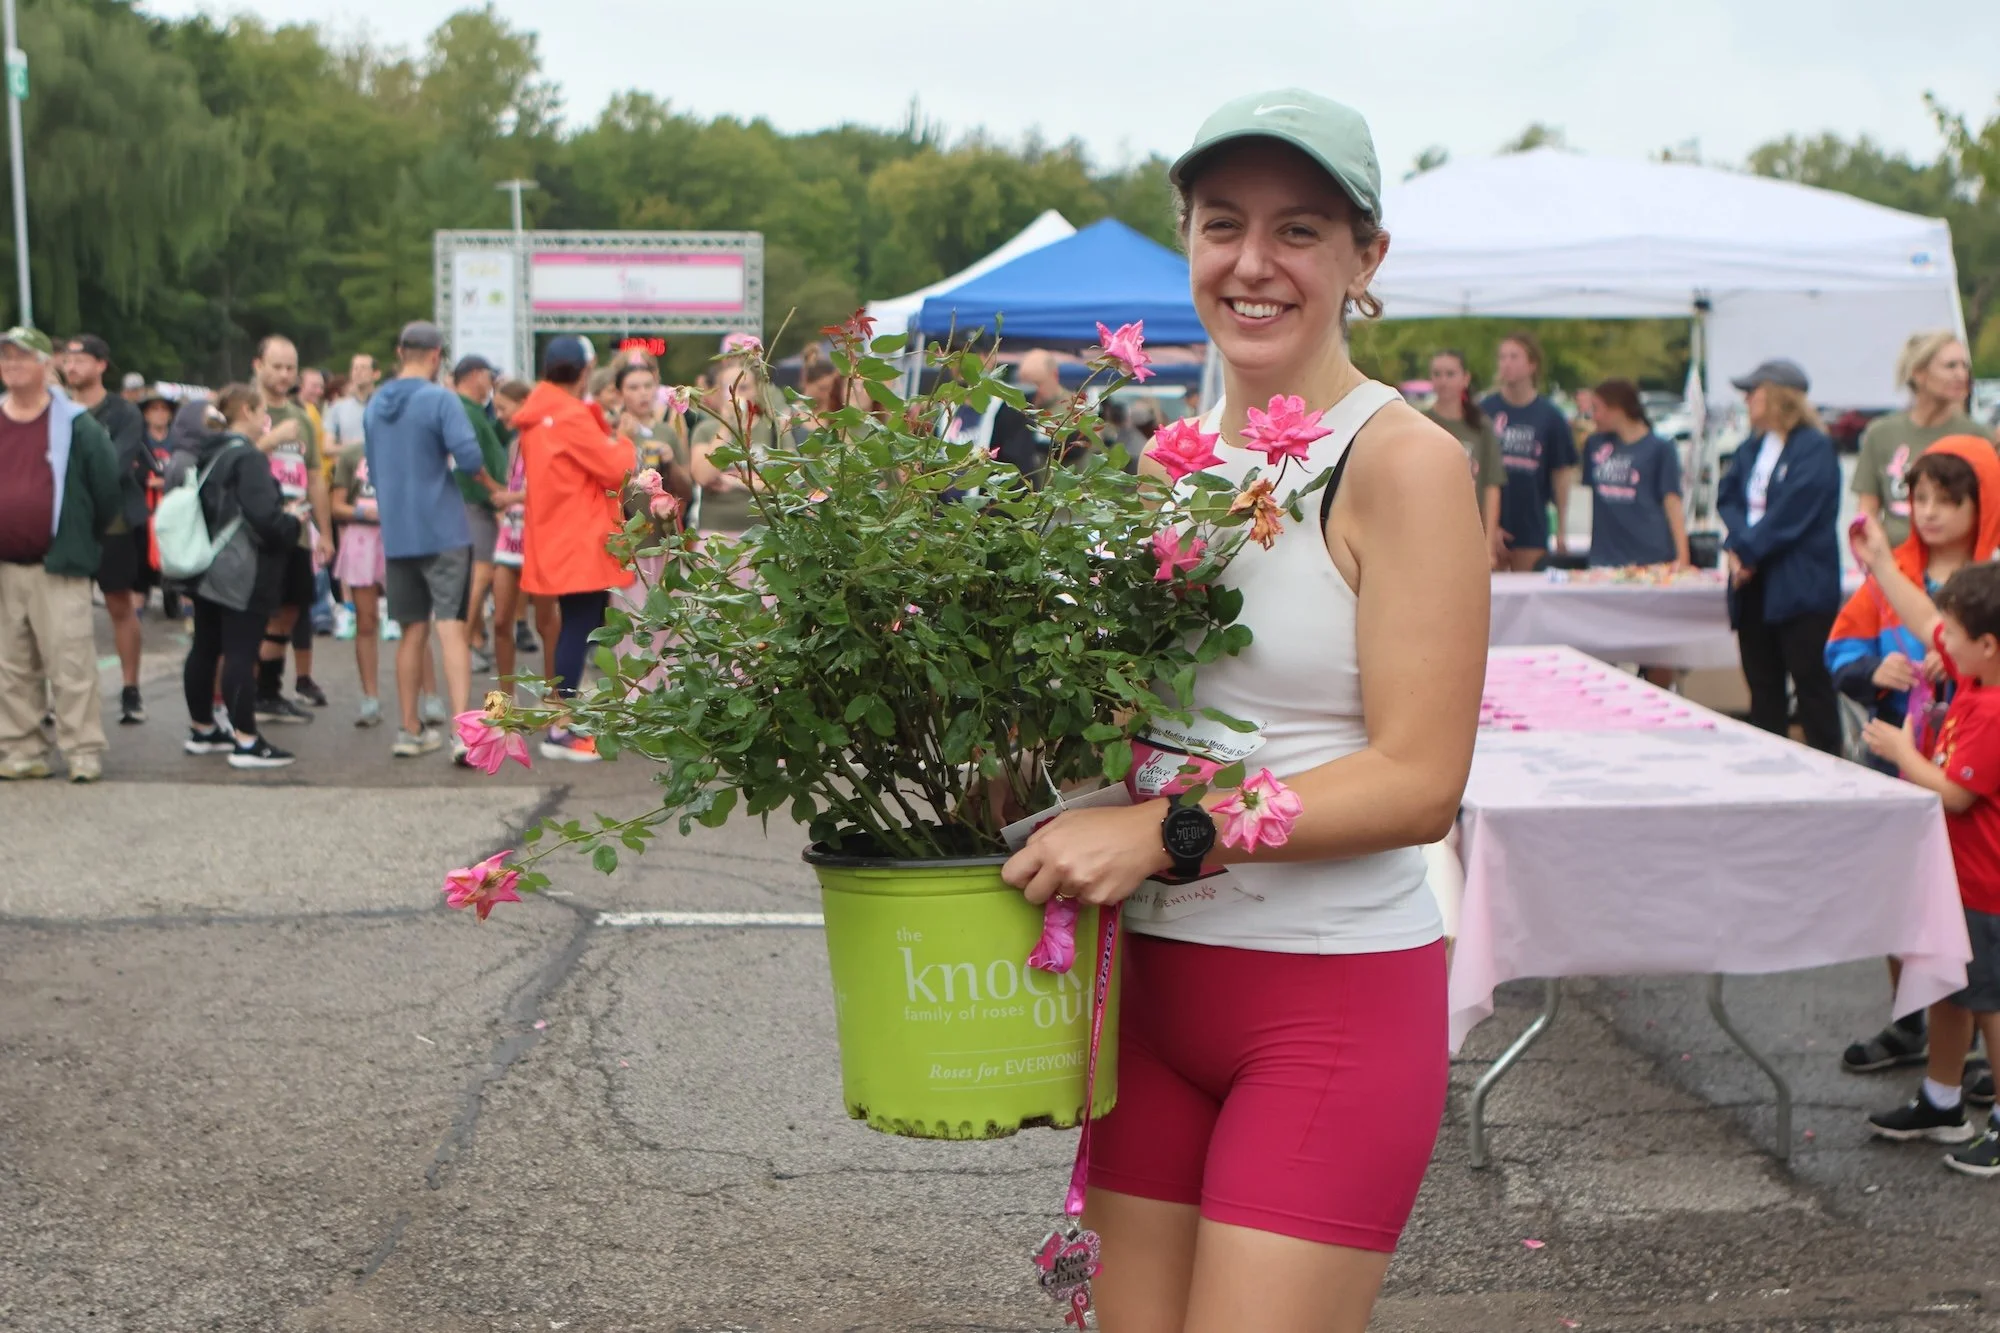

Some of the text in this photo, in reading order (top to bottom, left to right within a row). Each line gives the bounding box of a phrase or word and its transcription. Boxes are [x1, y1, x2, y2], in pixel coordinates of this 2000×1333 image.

[1208, 740, 1236, 756] Medical
[1139, 769, 1162, 784] Grace
[1147, 765, 1171, 777] Race
[896, 926, 923, 943] the
[1033, 975, 1094, 1029] out
[903, 1003, 1025, 1025] family of roses
[928, 1049, 1085, 1083] Roses for EVERYONE
[1041, 1268, 1091, 1287] Grace
